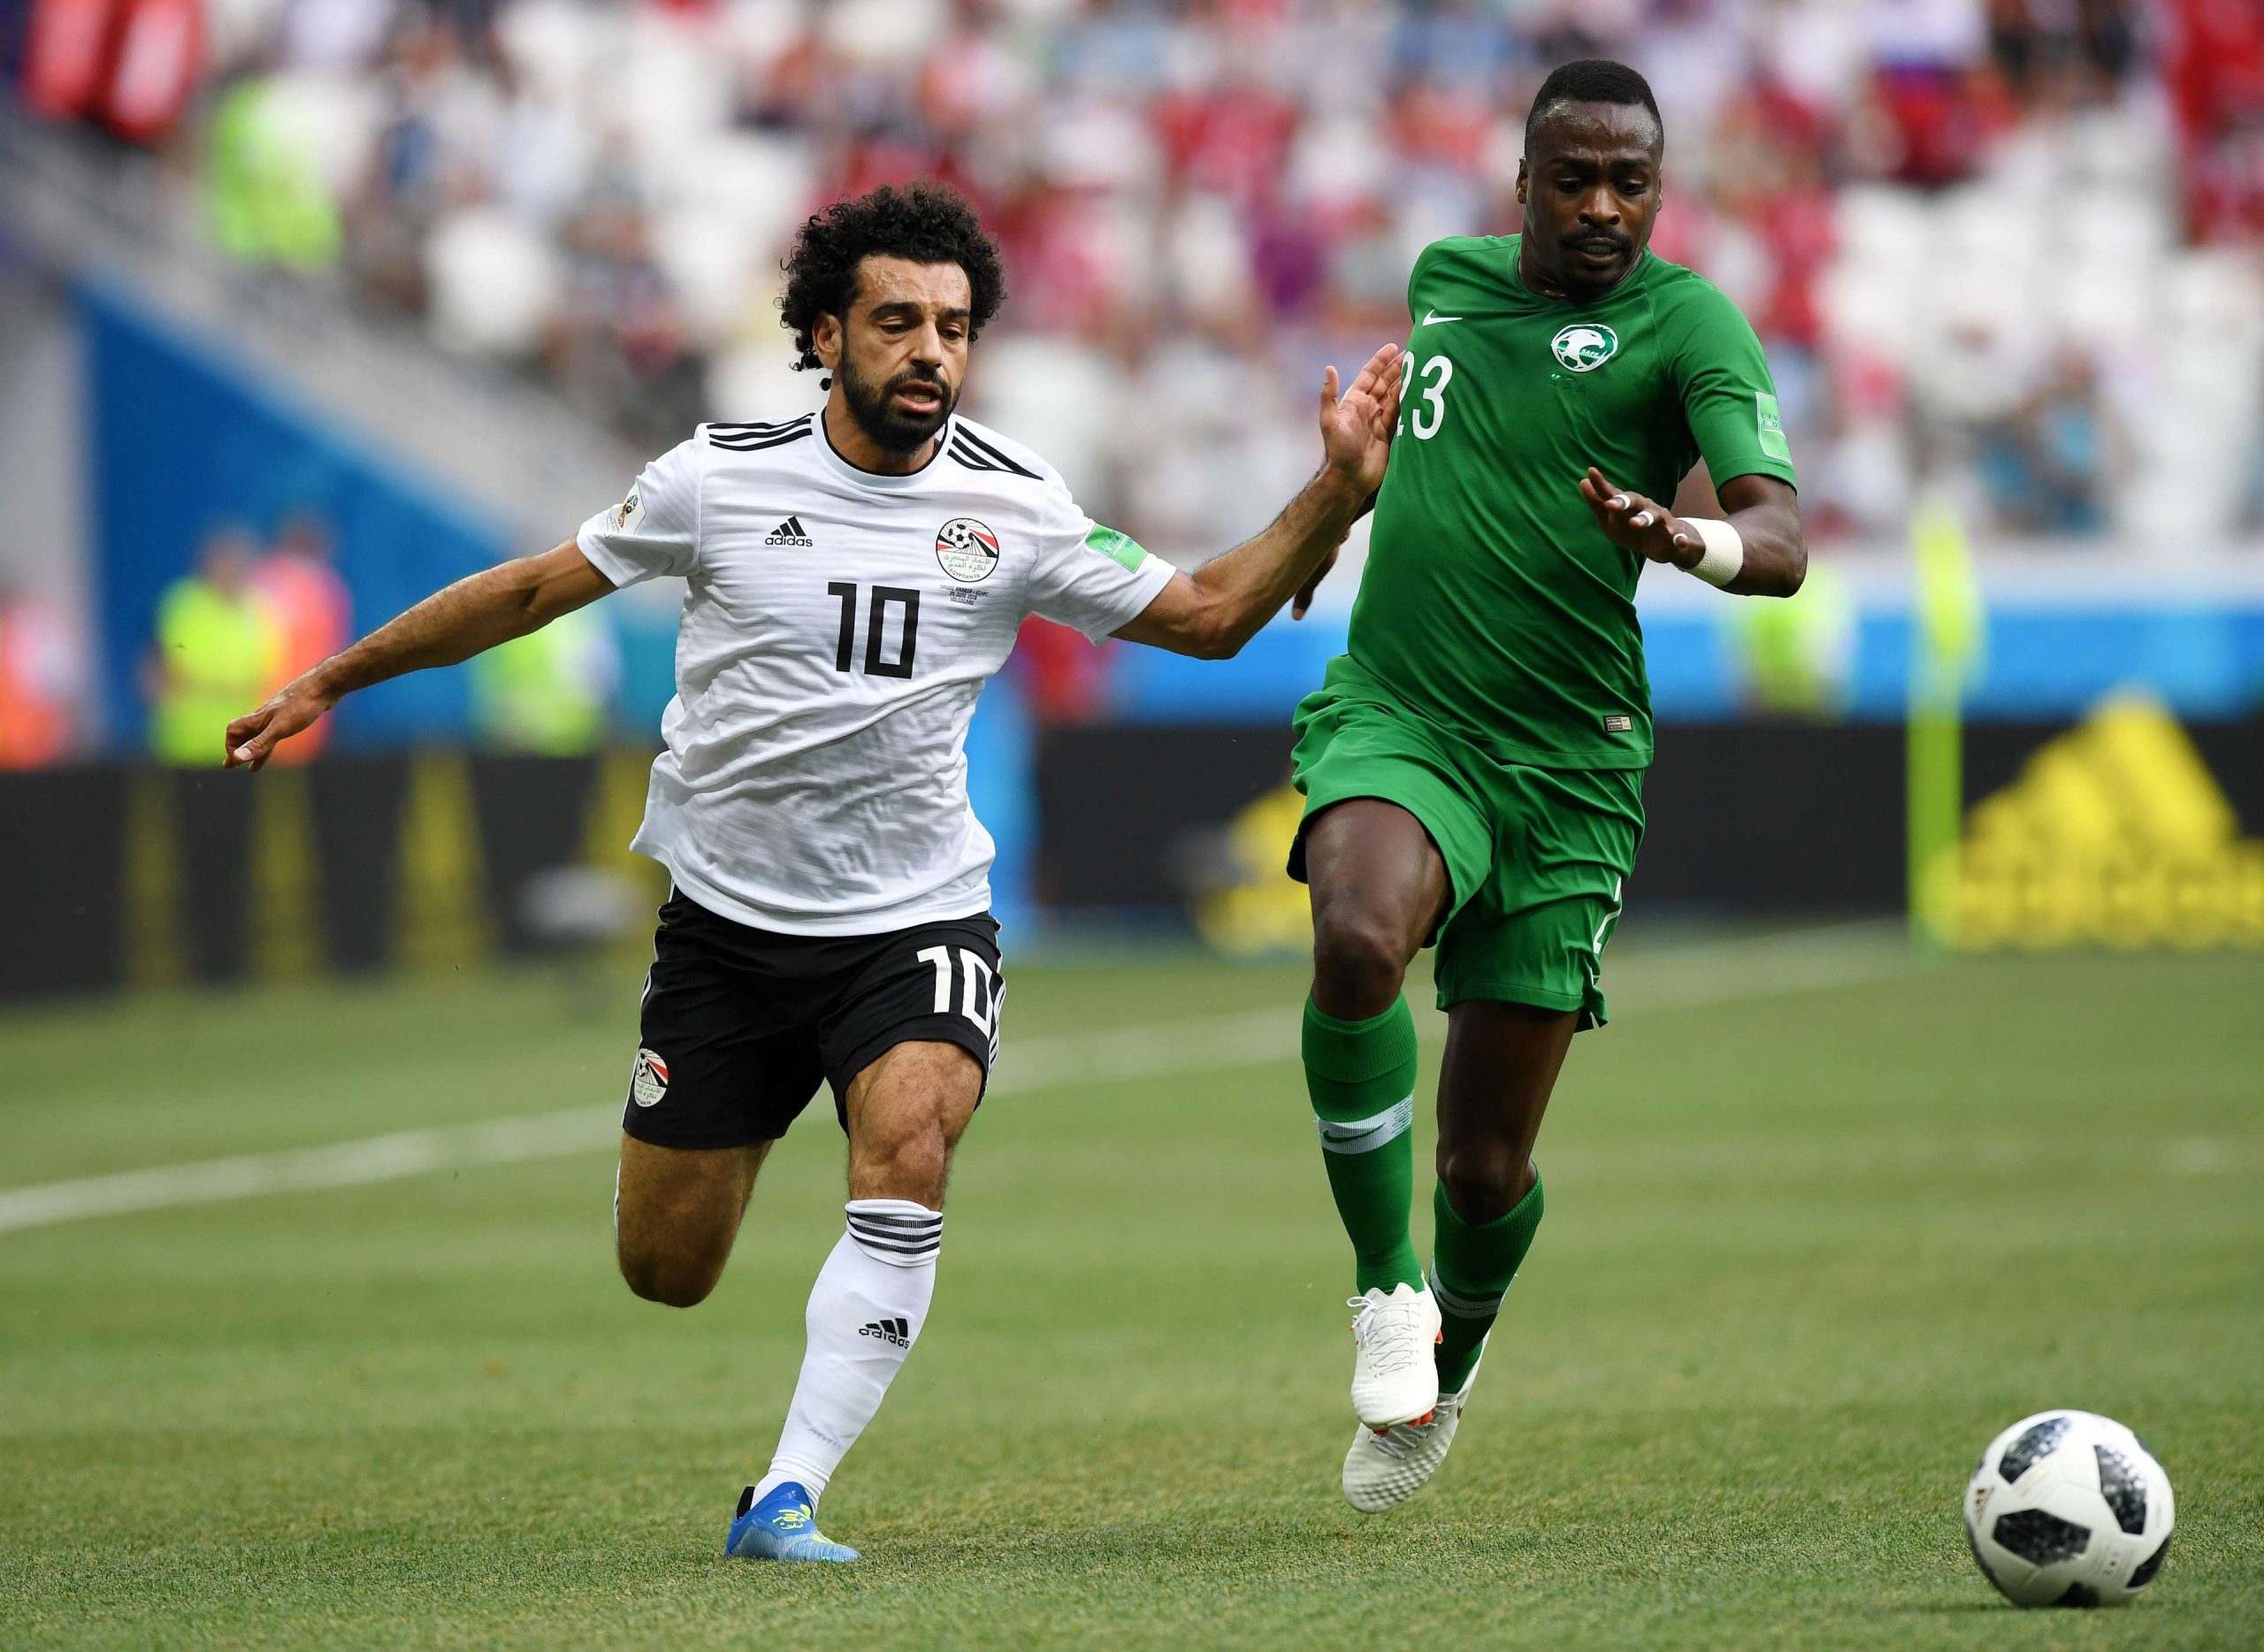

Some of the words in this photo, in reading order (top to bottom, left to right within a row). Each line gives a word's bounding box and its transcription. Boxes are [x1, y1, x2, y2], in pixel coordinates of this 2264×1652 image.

[1396, 350, 1453, 440] 23
[765, 534, 814, 547] adidas
[949, 568, 974, 579] EGYPTIAN
[828, 581, 921, 679] 10
[916, 945, 993, 1043] 10
[859, 1328, 910, 1350] adidas
